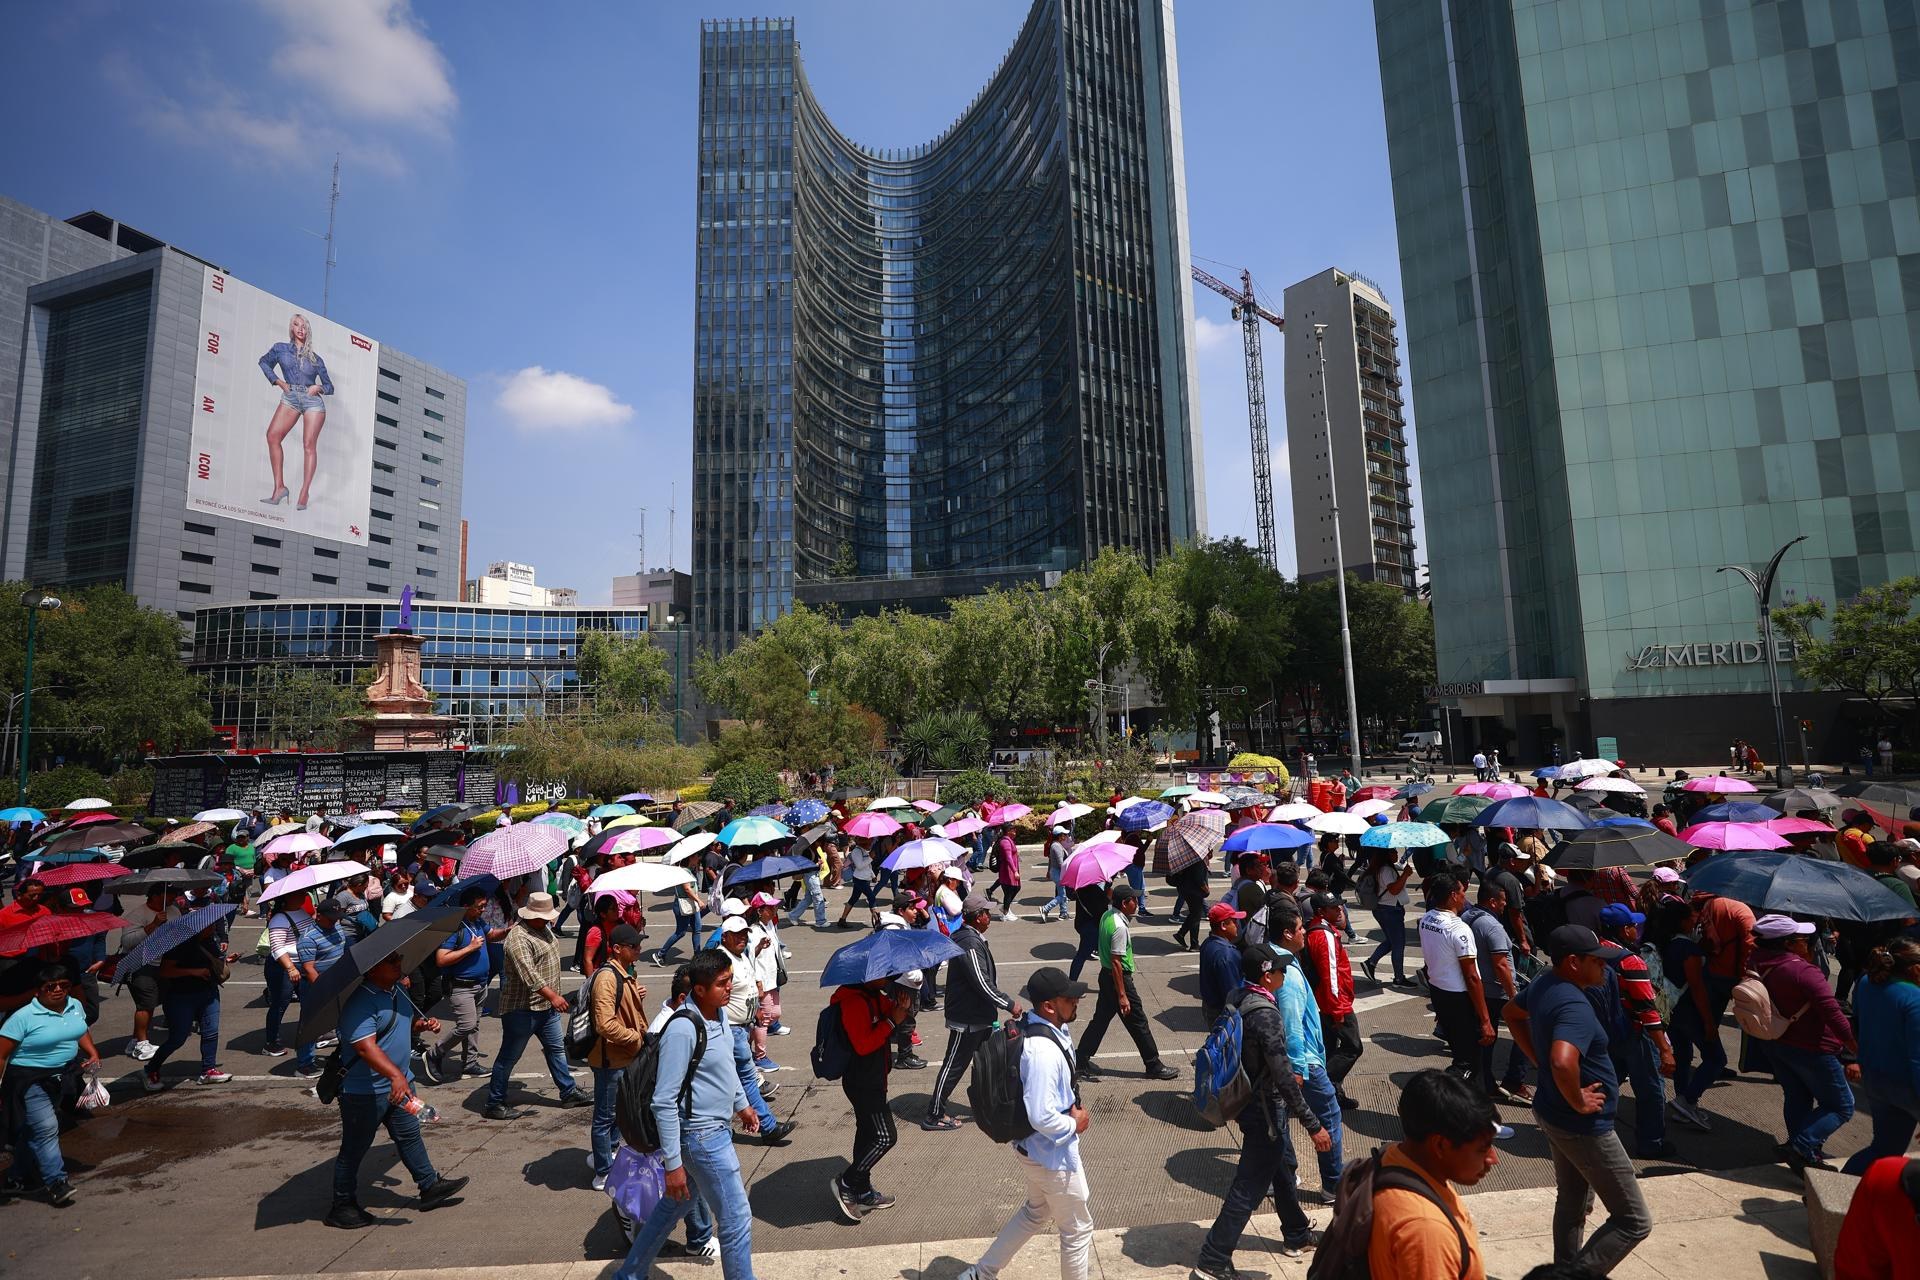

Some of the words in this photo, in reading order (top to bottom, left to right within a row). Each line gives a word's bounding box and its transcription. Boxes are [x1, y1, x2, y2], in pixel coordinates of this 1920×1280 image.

[212, 274, 224, 293] FIT
[207, 331, 220, 355] FOR
[202, 395, 215, 413] AN
[198, 453, 211, 480] ICON
[1664, 640, 1799, 667] MERIDE
[1435, 682, 1481, 697] MERIDIEN
[1425, 923, 1443, 934] SUZUKI
